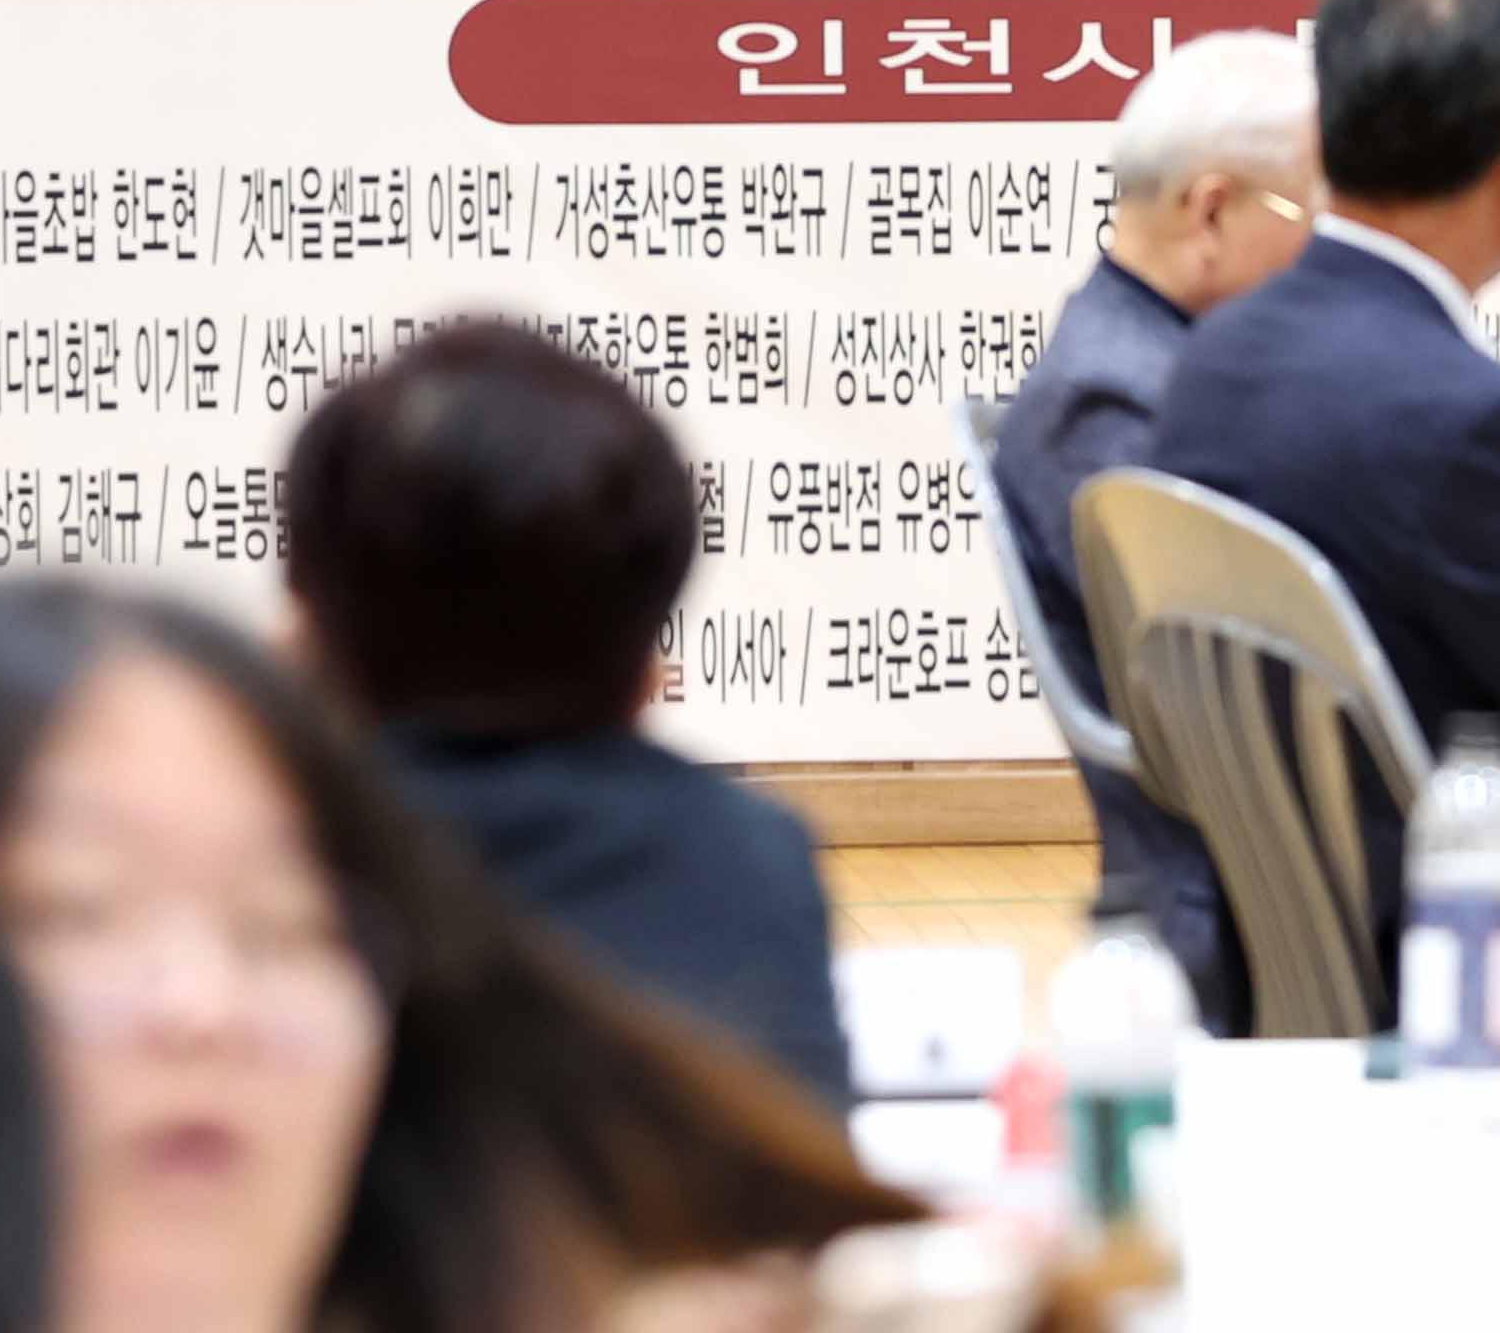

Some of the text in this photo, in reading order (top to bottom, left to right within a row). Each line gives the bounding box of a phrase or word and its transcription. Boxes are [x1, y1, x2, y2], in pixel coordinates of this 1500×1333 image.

[716, 15, 1177, 96] 인천시
[113, 167, 197, 262] 한도현
[240, 164, 412, 261] 갯마을셀프회
[428, 163, 513, 260] 이희만
[556, 161, 728, 259] 거성축산유통
[741, 161, 828, 258] 박완규
[867, 160, 953, 257] 골목집
[968, 159, 1052, 256] 이순연
[135, 316, 220, 413] 이기윤
[704, 310, 790, 407] 한범희
[831, 309, 947, 406] 성진상사
[58, 467, 143, 566] 김해규
[767, 459, 882, 555] 유풍반점
[701, 608, 787, 705] 이서아
[826, 607, 972, 703] 크라운호프
